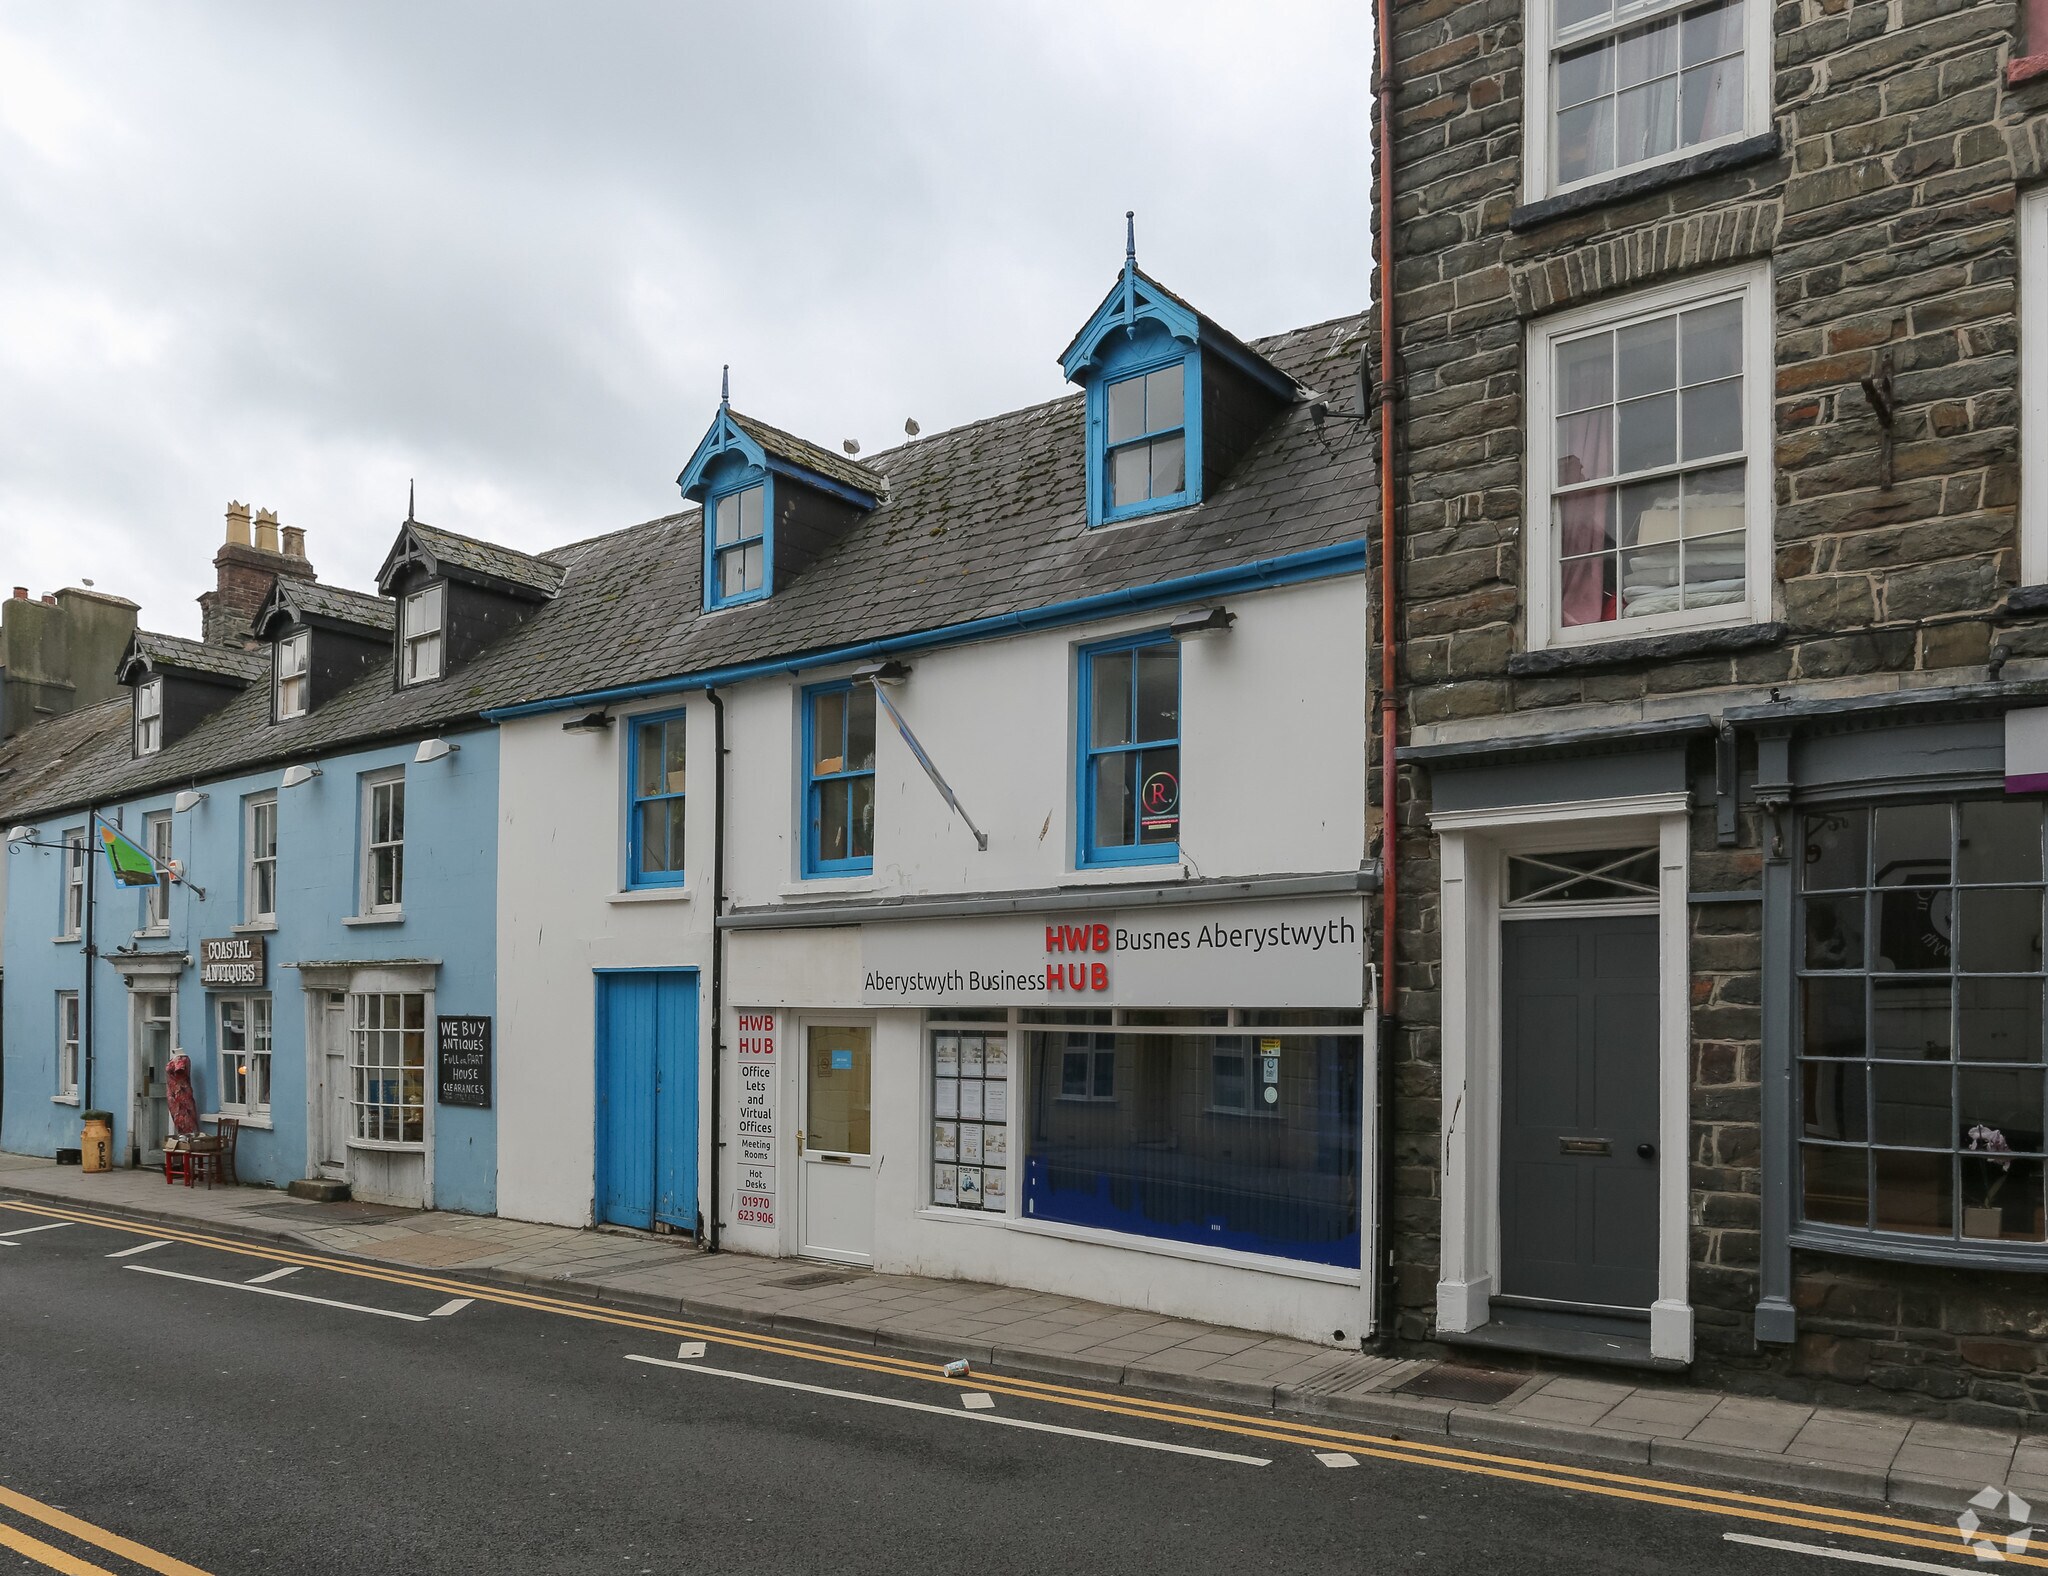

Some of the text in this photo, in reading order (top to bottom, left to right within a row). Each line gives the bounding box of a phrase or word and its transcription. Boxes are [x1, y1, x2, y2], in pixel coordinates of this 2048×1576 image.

[1045, 916, 1355, 953] HWB Busnes Aberystwyth
[208, 940, 252, 960] COASTAL
[204, 963, 255, 984] ANTIQUES
[864, 962, 1109, 995] Aberystwyth Business HUB
[441, 1021, 486, 1037] WE BUY
[739, 1014, 774, 1032] HWB
[442, 1038, 484, 1051] ANTIQUES
[739, 1037, 774, 1054] HUB
[466, 1053, 484, 1065] PART
[453, 1067, 479, 1081] HOUSE
[742, 1065, 770, 1078] Office
[443, 1082, 485, 1095] CLEARANCES
[746, 1080, 766, 1092] Lets
[747, 1094, 764, 1105] and
[740, 1107, 772, 1120] Virtual
[739, 1121, 772, 1134] Offices
[741, 1139, 771, 1152] Meeting
[97, 1141, 107, 1169] OPEN
[744, 1150, 768, 1160] Rooms
[749, 1169, 763, 1179] Hot
[745, 1179, 767, 1190] Desks
[741, 1195, 770, 1210] 01970
[737, 1209, 774, 1225] 623 906
